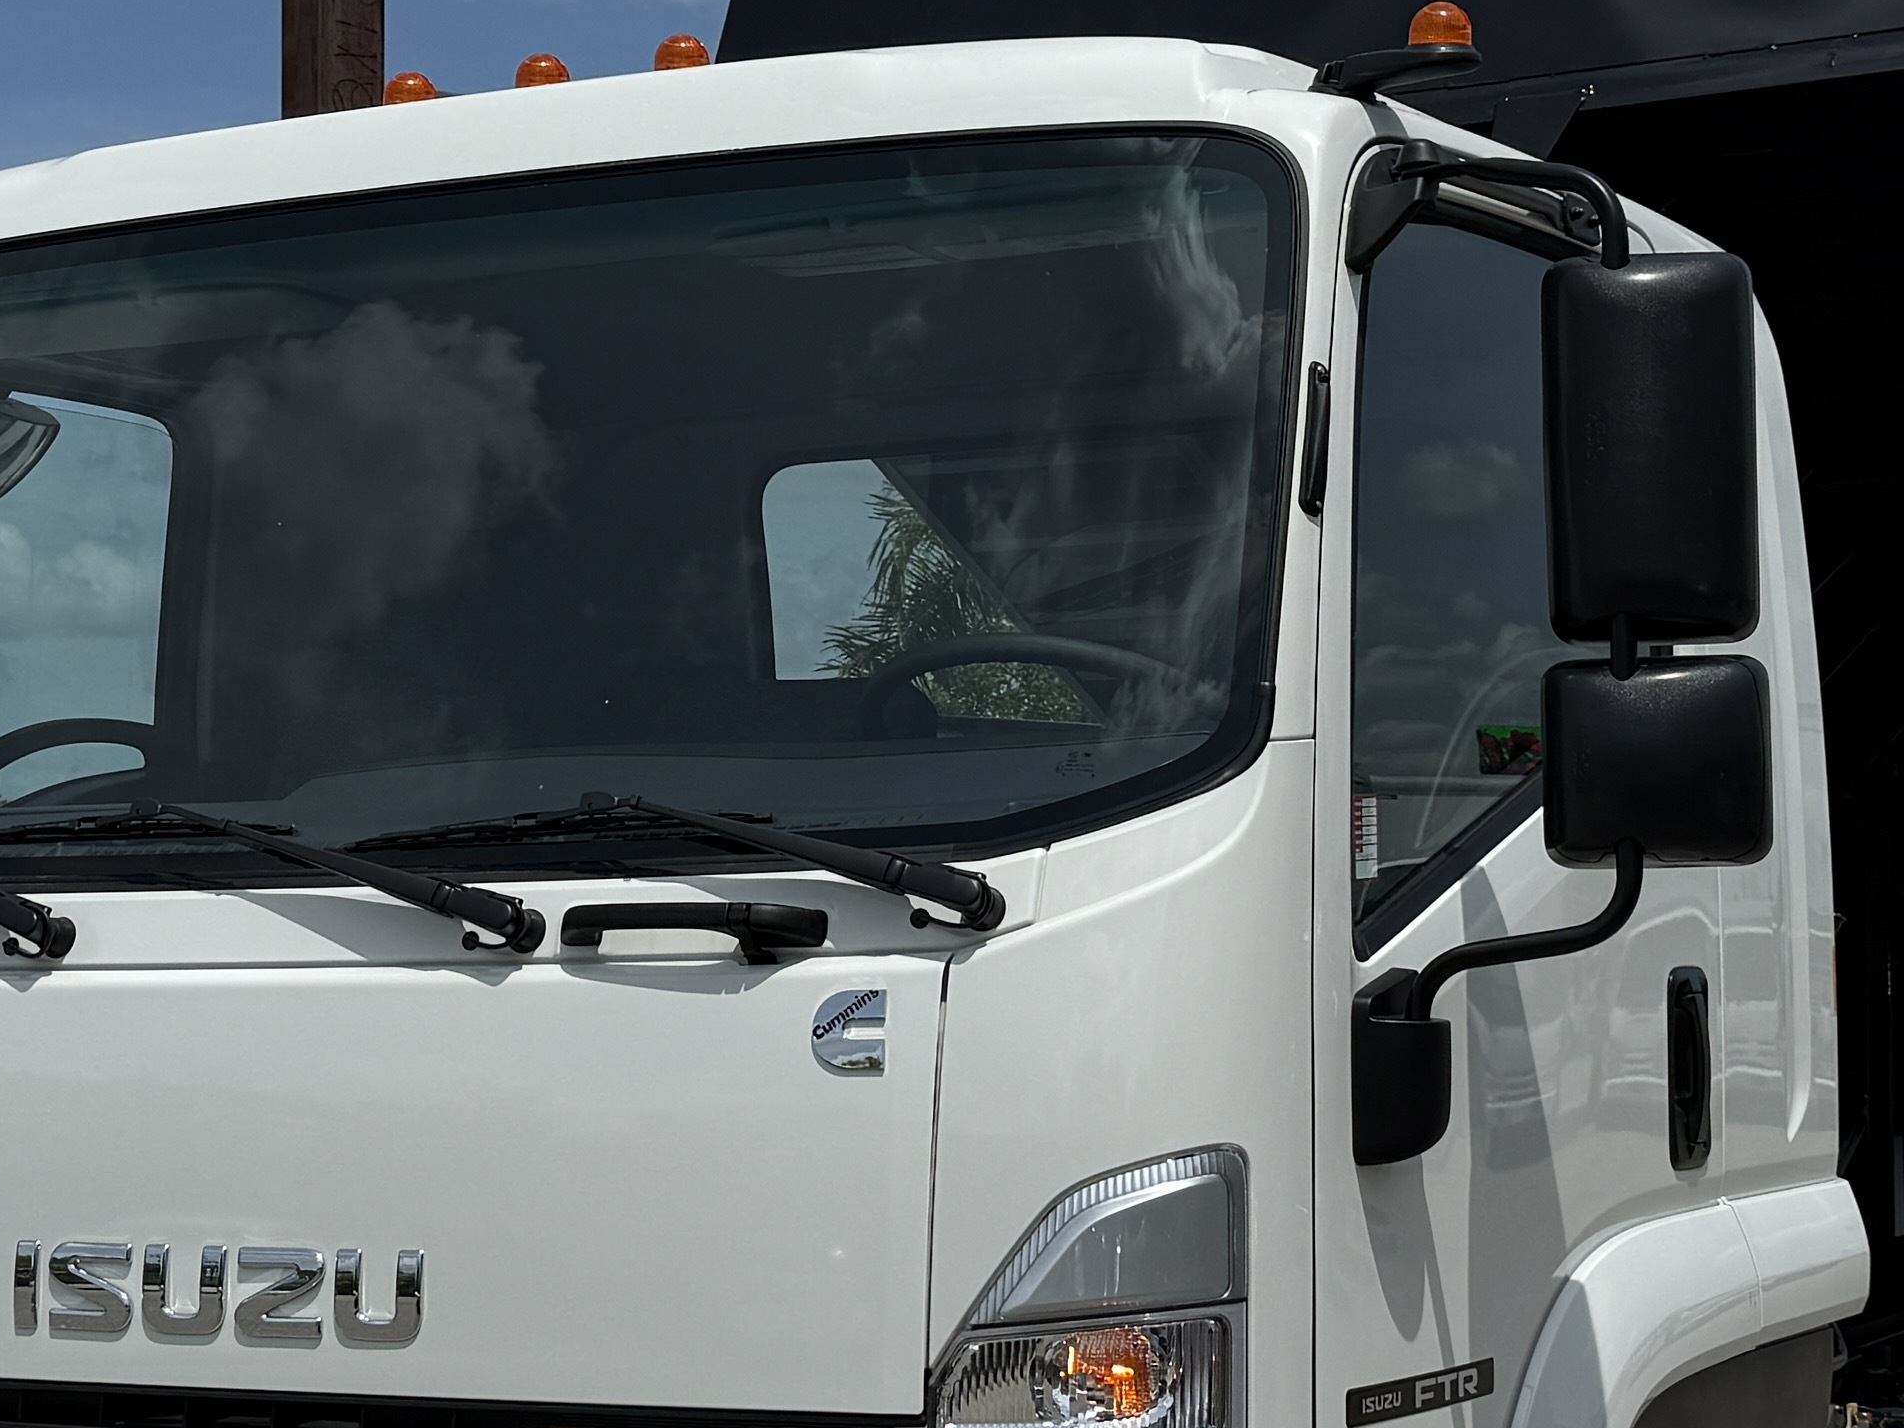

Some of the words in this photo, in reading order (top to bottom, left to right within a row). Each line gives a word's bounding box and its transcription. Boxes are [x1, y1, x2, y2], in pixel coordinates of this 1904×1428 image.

[812, 989, 880, 1040] Cummins
[13, 1239, 425, 1344] ISUZU
[1362, 1391, 1402, 1414] ISUZU
[1415, 1367, 1478, 1409] FTR
